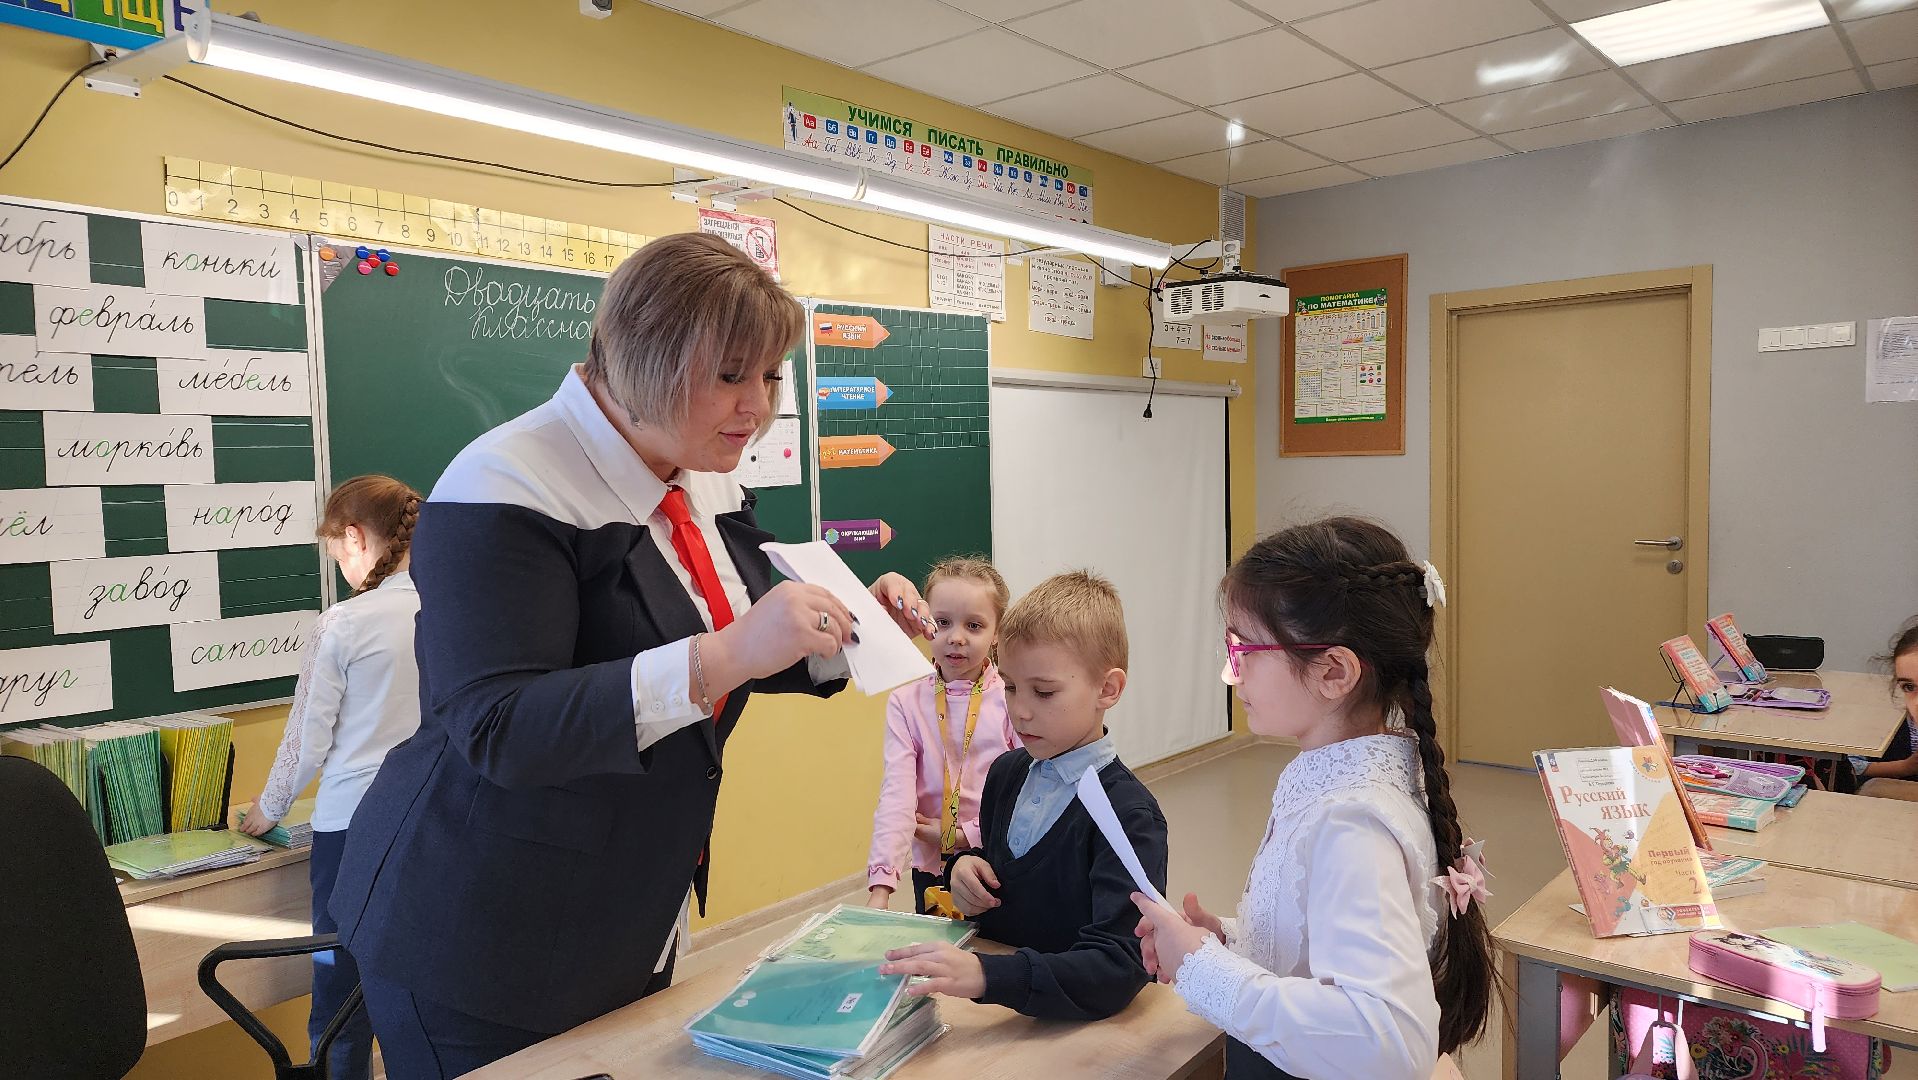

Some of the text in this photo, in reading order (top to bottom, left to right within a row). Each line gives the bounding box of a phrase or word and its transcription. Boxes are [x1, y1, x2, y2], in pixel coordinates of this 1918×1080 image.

[847, 105, 1069, 178] УЧИМСЯ ПИСАТЬ ПРАВИЛЬНО
[168, 190, 179, 208] 0
[196, 194, 204, 211] 1
[227, 199, 239, 216] 2
[259, 203, 270, 220] 3
[289, 208, 300, 224] 4
[319, 212, 329, 228] 5
[347, 216, 358, 232] 6
[375, 220, 385, 234] 7
[401, 224, 410, 239] 8
[426, 228, 436, 243] 9
[448, 231, 463, 247] 10
[496, 238, 511, 253] 12
[518, 241, 532, 256] 13
[540, 245, 553, 259] 14
[561, 248, 574, 262] 15
[583, 251, 596, 265] 16
[603, 254, 615, 268] 17
[941, 232, 993, 250] ЧАСТИ РЕЧИ
[444, 265, 596, 327] Двадцать
[1320, 292, 1360, 302] ПОМОГАЙКА
[1320, 297, 1374, 309] МАТЕМАТИКЕ
[470, 306, 593, 340] Классна
[836, 323, 867, 332] РУССКИЙ
[842, 332, 861, 340] ЯЗЫК
[838, 447, 878, 456] МАТЕМАТИКА
[0, 511, 54, 537] ёл
[840, 528, 879, 537] ОКРУЖАЮЩИЙ
[1559, 785, 1627, 807] Русский
[1648, 846, 1690, 858] Первый
[1688, 876, 1702, 894] 2
